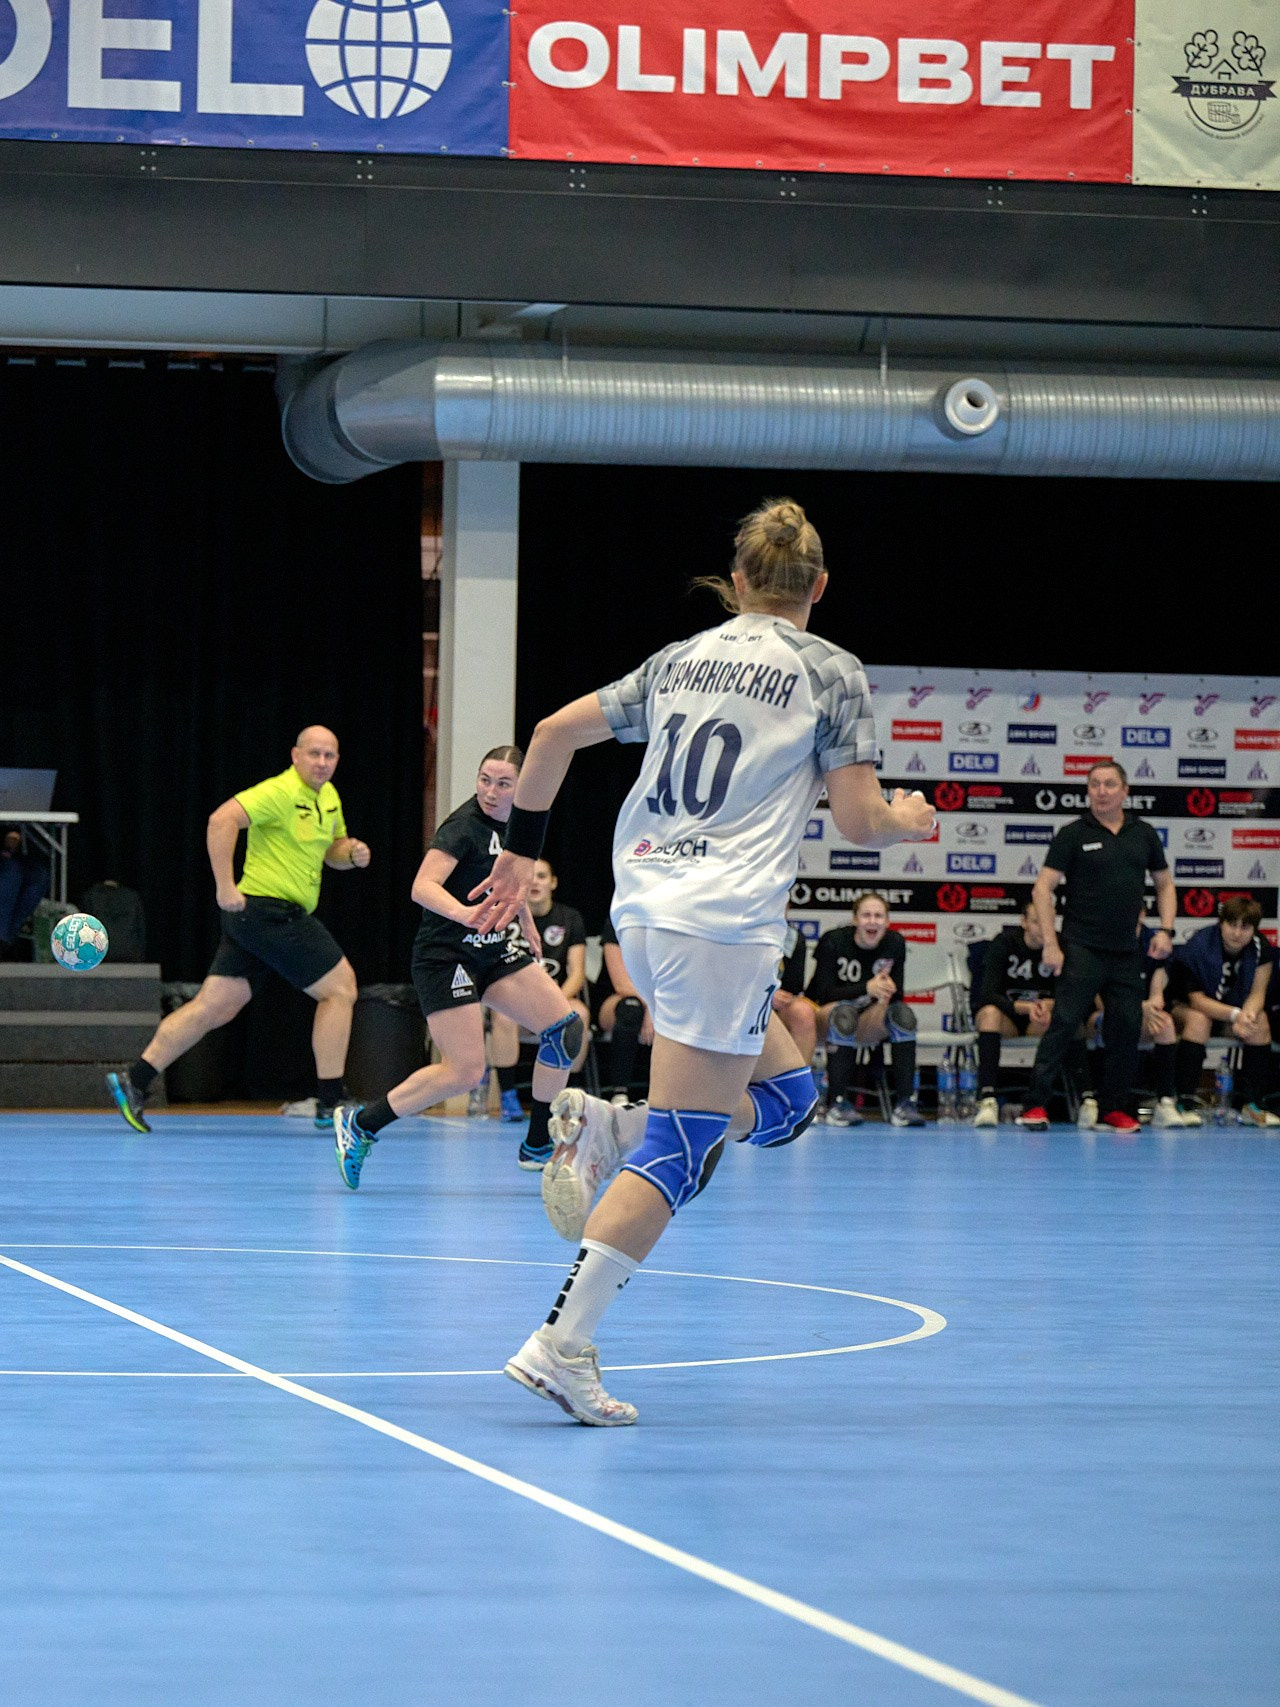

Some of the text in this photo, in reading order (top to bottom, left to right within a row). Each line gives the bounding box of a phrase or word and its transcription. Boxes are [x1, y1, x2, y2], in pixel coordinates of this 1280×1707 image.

[527, 21, 1116, 110] OLIMPBET
[1190, 84, 1256, 97] ДУБРАВА
[659, 659, 799, 709] ШАМАНОВСКАЯ
[645, 712, 742, 820] 10
[1060, 793, 1156, 810] OLIBET
[65, 917, 81, 949] SELECT
[836, 956, 862, 983] 20
[1007, 954, 1033, 981] 24
